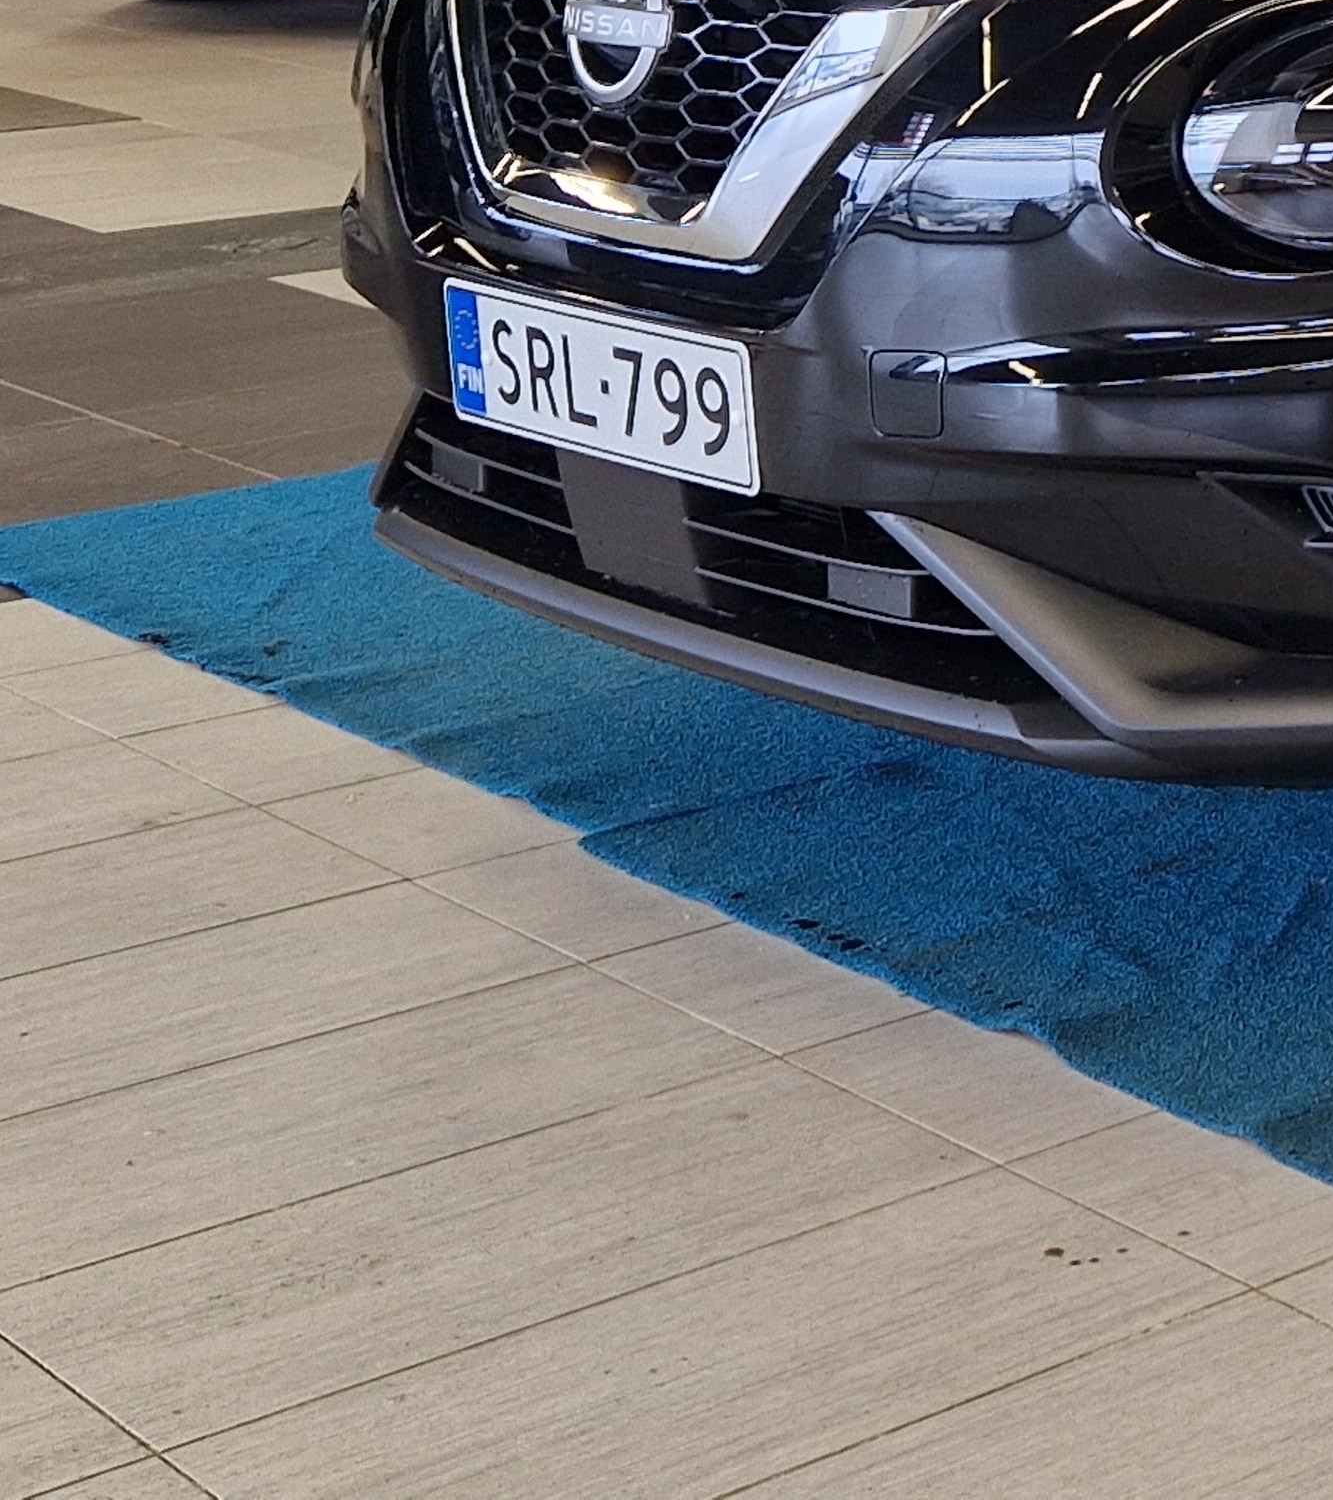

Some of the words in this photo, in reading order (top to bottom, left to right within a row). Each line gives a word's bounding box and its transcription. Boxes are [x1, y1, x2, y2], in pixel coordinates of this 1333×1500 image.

[563, 4, 662, 39] NISSAN
[457, 363, 484, 395] FIN
[491, 318, 731, 457] SRL-799
